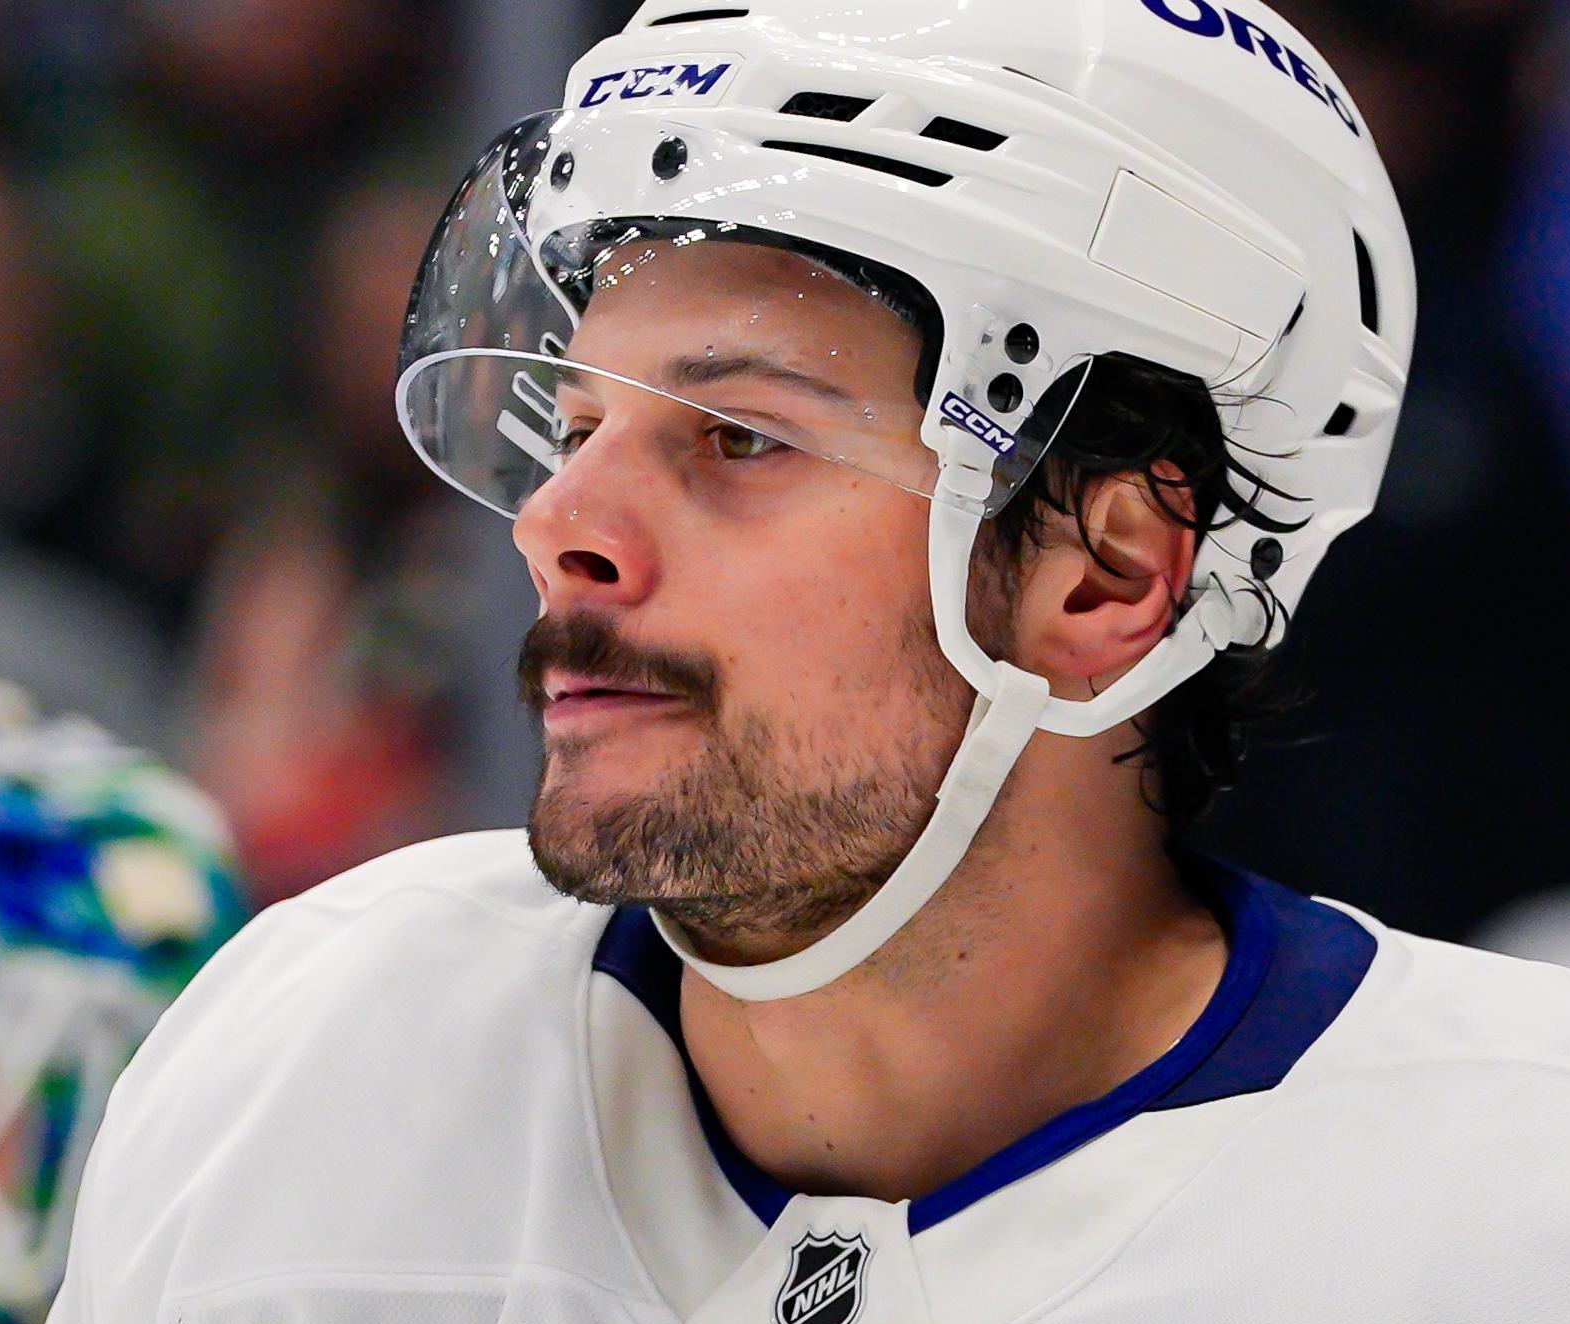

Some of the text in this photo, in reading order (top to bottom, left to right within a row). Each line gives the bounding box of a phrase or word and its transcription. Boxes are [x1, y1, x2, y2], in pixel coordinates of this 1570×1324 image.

[579, 63, 732, 108] CCM
[944, 398, 1015, 452] CCM
[790, 1258, 855, 1322] NHL
